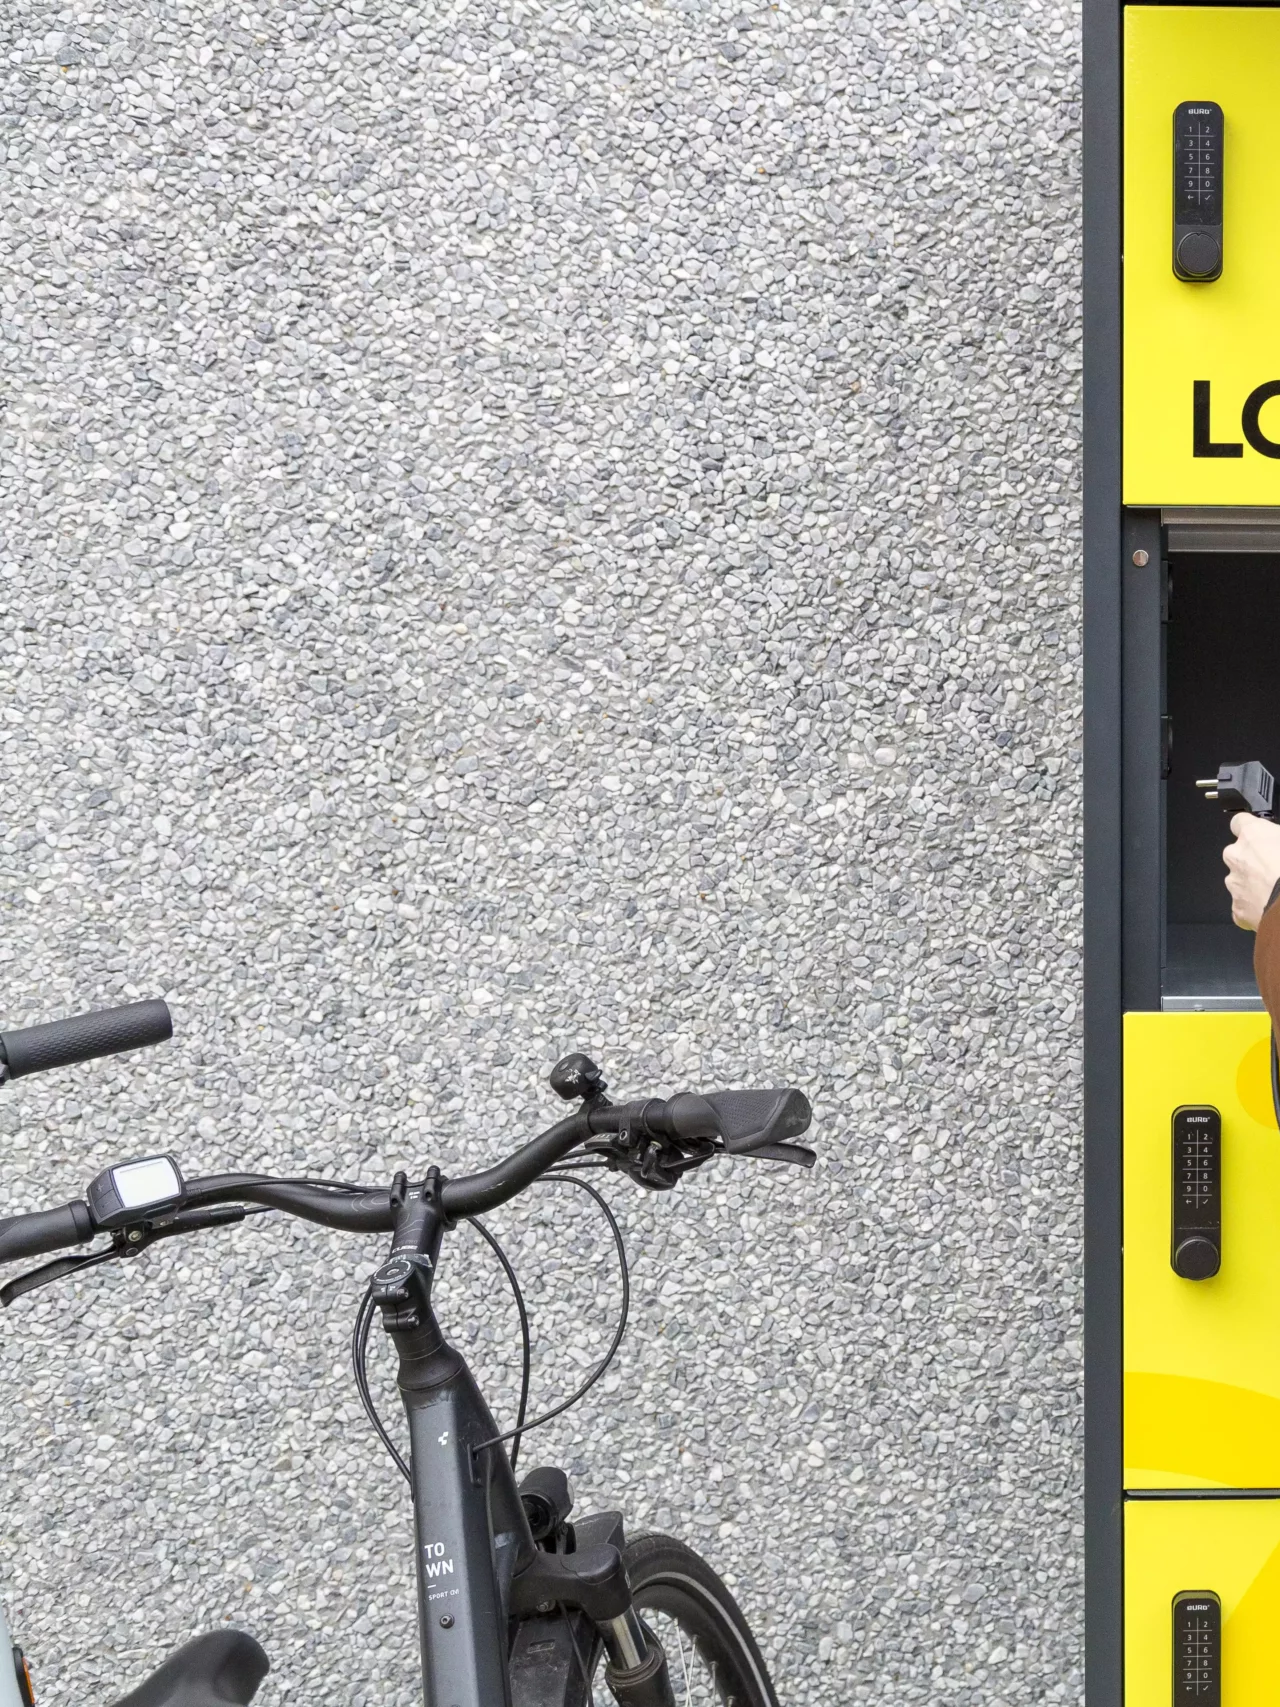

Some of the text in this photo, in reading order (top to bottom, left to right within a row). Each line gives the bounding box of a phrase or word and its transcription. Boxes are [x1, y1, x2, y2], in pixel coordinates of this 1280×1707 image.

[424, 1542, 445, 1559] TO
[425, 1559, 454, 1578] WN
[428, 1591, 448, 1601] SPORT
